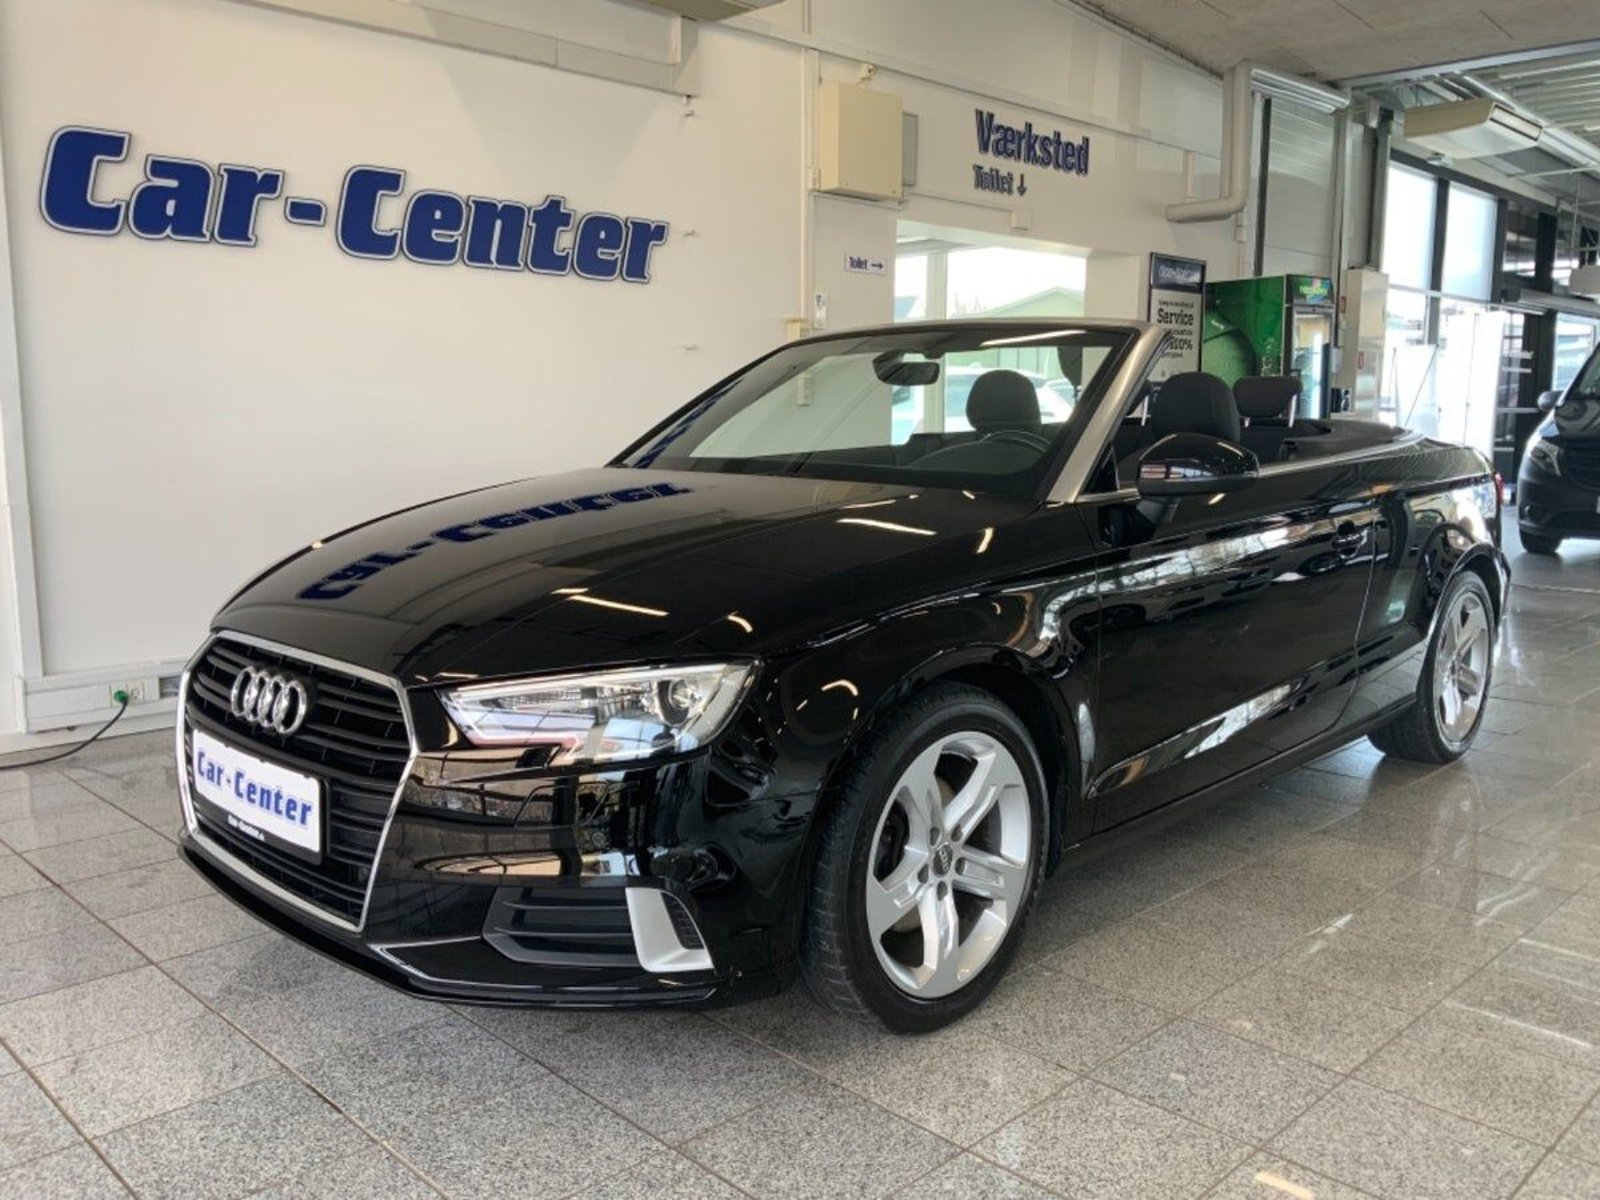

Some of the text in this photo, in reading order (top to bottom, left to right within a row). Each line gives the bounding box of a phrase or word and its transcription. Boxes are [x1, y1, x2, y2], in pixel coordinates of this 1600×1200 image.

[975, 108, 1090, 175] Værksted
[39, 125, 668, 283] Car-Center
[973, 164, 1013, 195] Toilet
[849, 256, 868, 270] Toilet
[1157, 307, 1194, 326] Service
[197, 751, 312, 825] Car-Center
